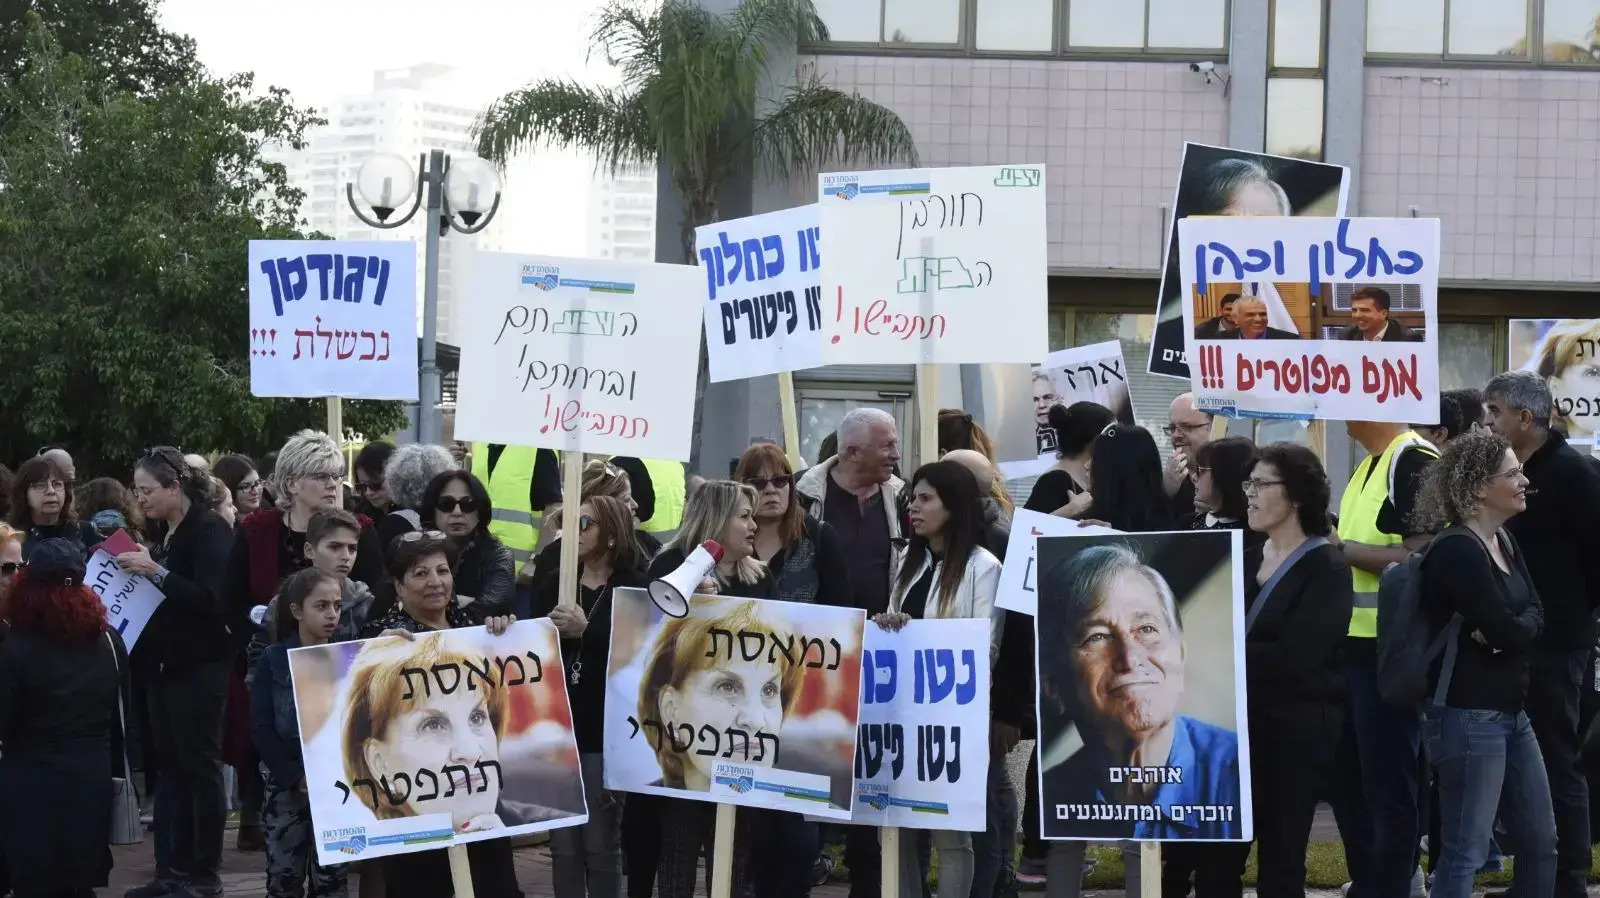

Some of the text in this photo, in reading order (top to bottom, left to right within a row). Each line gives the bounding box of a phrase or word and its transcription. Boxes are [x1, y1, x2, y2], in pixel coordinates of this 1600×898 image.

[896, 192, 982, 260] חורבן
[260, 253, 390, 316] ויגודמן
[700, 227, 820, 300] טו כחלון
[1195, 219, 1424, 296] כחלון וכהן
[252, 316, 390, 361] נכשלת !!!
[720, 288, 798, 346] פיטורים
[1063, 360, 1124, 390] ארז
[1199, 345, 1422, 403] אתם מפוטרים !!!
[110, 574, 144, 615] רושלים
[402, 650, 543, 701] נמאסת
[705, 626, 841, 671] נמאסת
[913, 648, 976, 705] נטו
[627, 715, 780, 765] תתפטרי
[855, 722, 961, 784] נטו פיטו
[334, 755, 504, 812] תתפטרי
[1109, 765, 1182, 783] אוהבים
[1055, 804, 1234, 822] זוכרים ומתגעגעים
